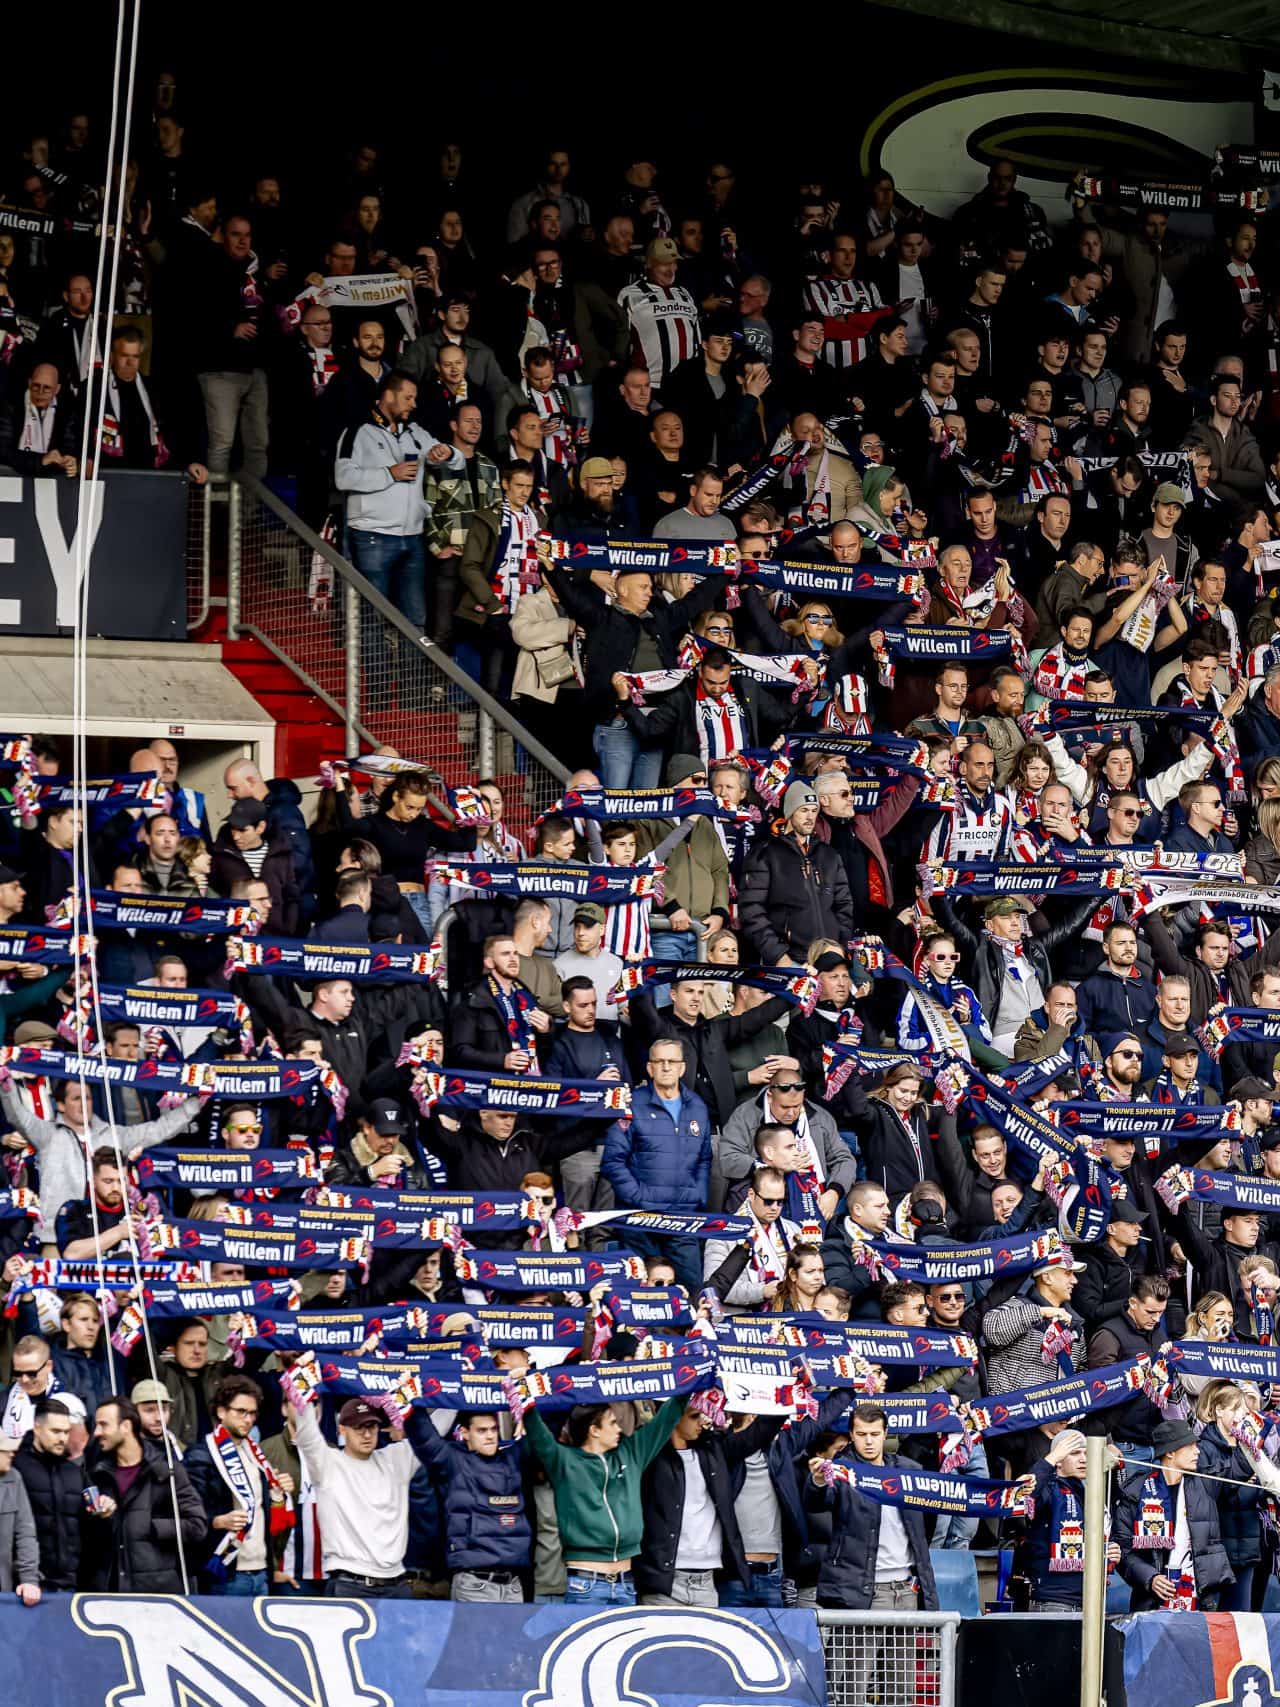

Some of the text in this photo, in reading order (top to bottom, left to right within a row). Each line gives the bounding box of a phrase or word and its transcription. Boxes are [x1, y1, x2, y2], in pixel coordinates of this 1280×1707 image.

[1141, 191, 1188, 207] Willem
[609, 550, 656, 565] Willem
[782, 572, 838, 590] Willem
[907, 638, 957, 653] Willem
[605, 799, 658, 813] Willem
[995, 876, 1042, 889] Willem
[117, 907, 167, 923] Willem
[304, 956, 356, 973] Willem
[125, 1000, 182, 1019] Willem
[488, 1089, 543, 1107] Willem
[1104, 1118, 1158, 1131] Willem
[224, 1240, 280, 1260] Willem
[519, 1269, 572, 1285] Willem
[925, 1263, 981, 1278] Willem
[720, 1356, 776, 1376] Willem
[1208, 1356, 1264, 1374] Willem
[598, 1378, 660, 1396] Willem
[1029, 1397, 1079, 1419] Willem
[914, 1477, 967, 1498] Willem
